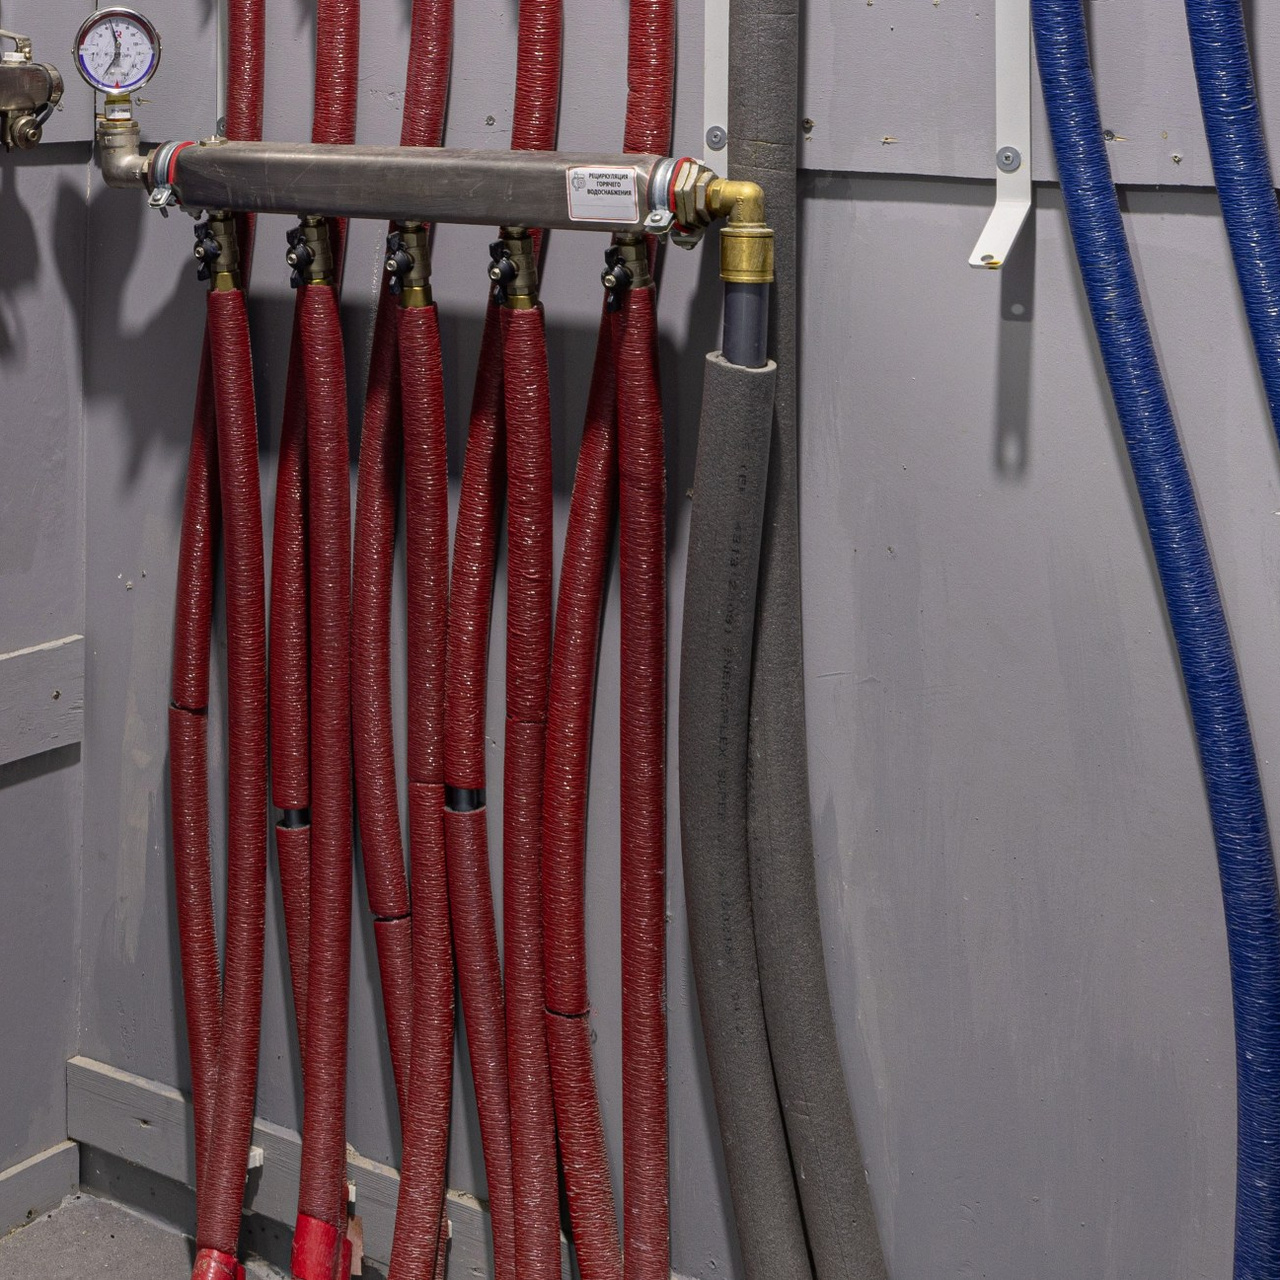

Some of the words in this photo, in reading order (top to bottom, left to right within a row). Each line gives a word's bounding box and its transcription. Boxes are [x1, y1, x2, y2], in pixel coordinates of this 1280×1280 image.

[588, 172, 629, 181] РЕЦИРКУЛЯЦИЯ
[596, 180, 622, 188] ГОРЯЧЕГО
[586, 188, 632, 197] ВОДОСНАБЖЕНИЯ
